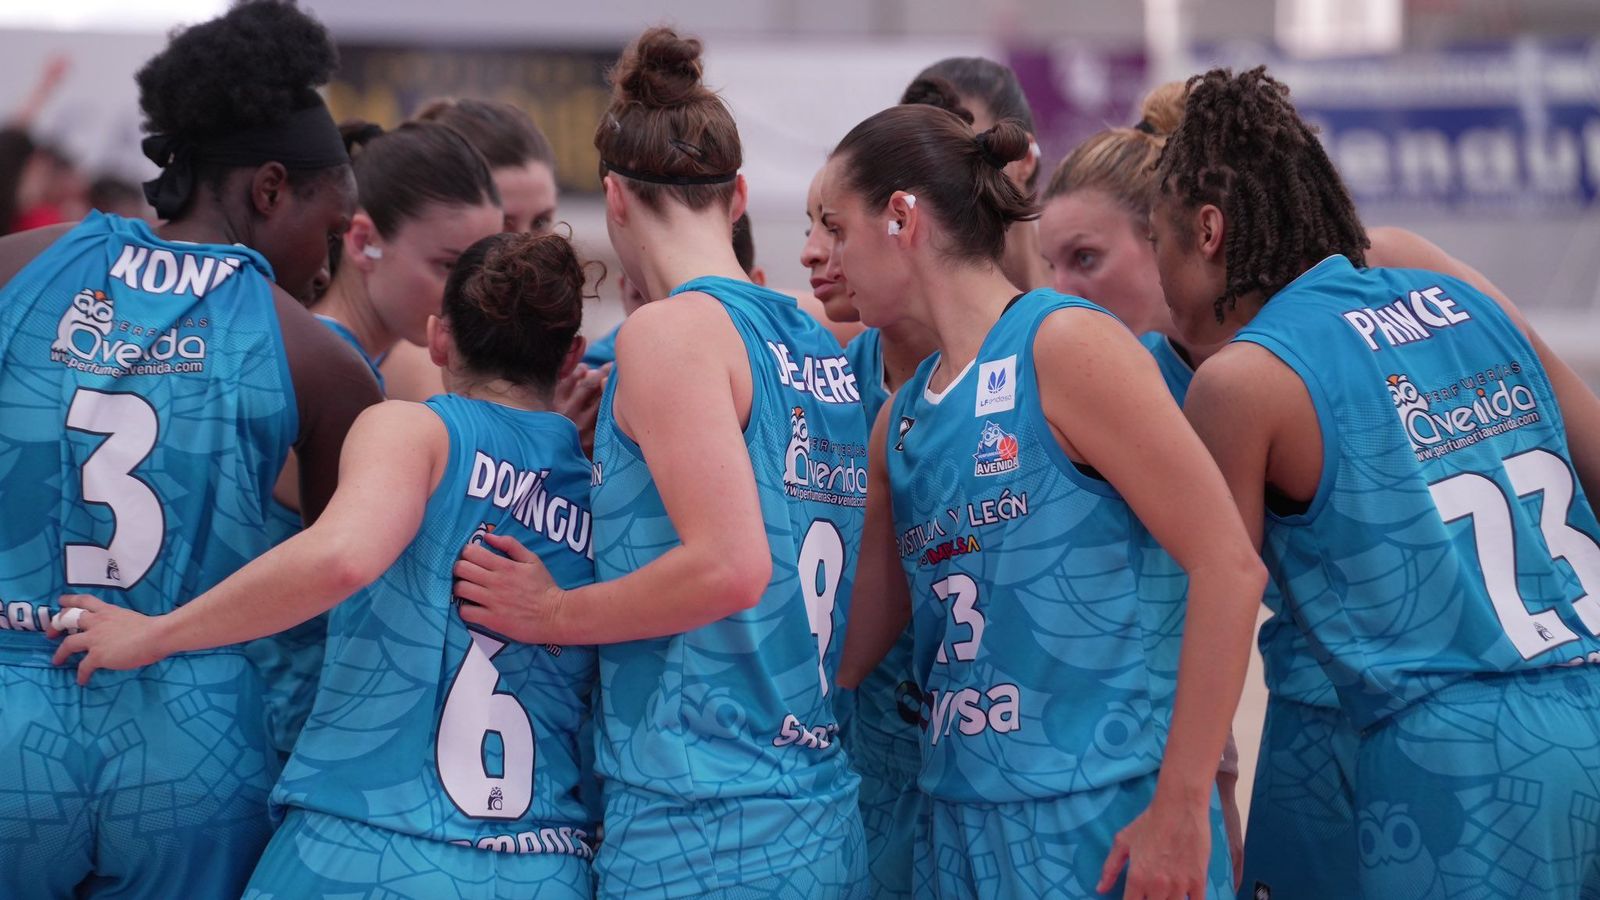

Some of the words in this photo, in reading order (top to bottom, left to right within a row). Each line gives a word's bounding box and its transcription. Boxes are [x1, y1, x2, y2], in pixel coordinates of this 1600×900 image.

[64, 386, 166, 592] 3
[466, 448, 593, 560] DOMÍNGU
[967, 488, 1029, 527] LEÓN
[1427, 447, 1600, 662] 23
[434, 624, 535, 821] 6
